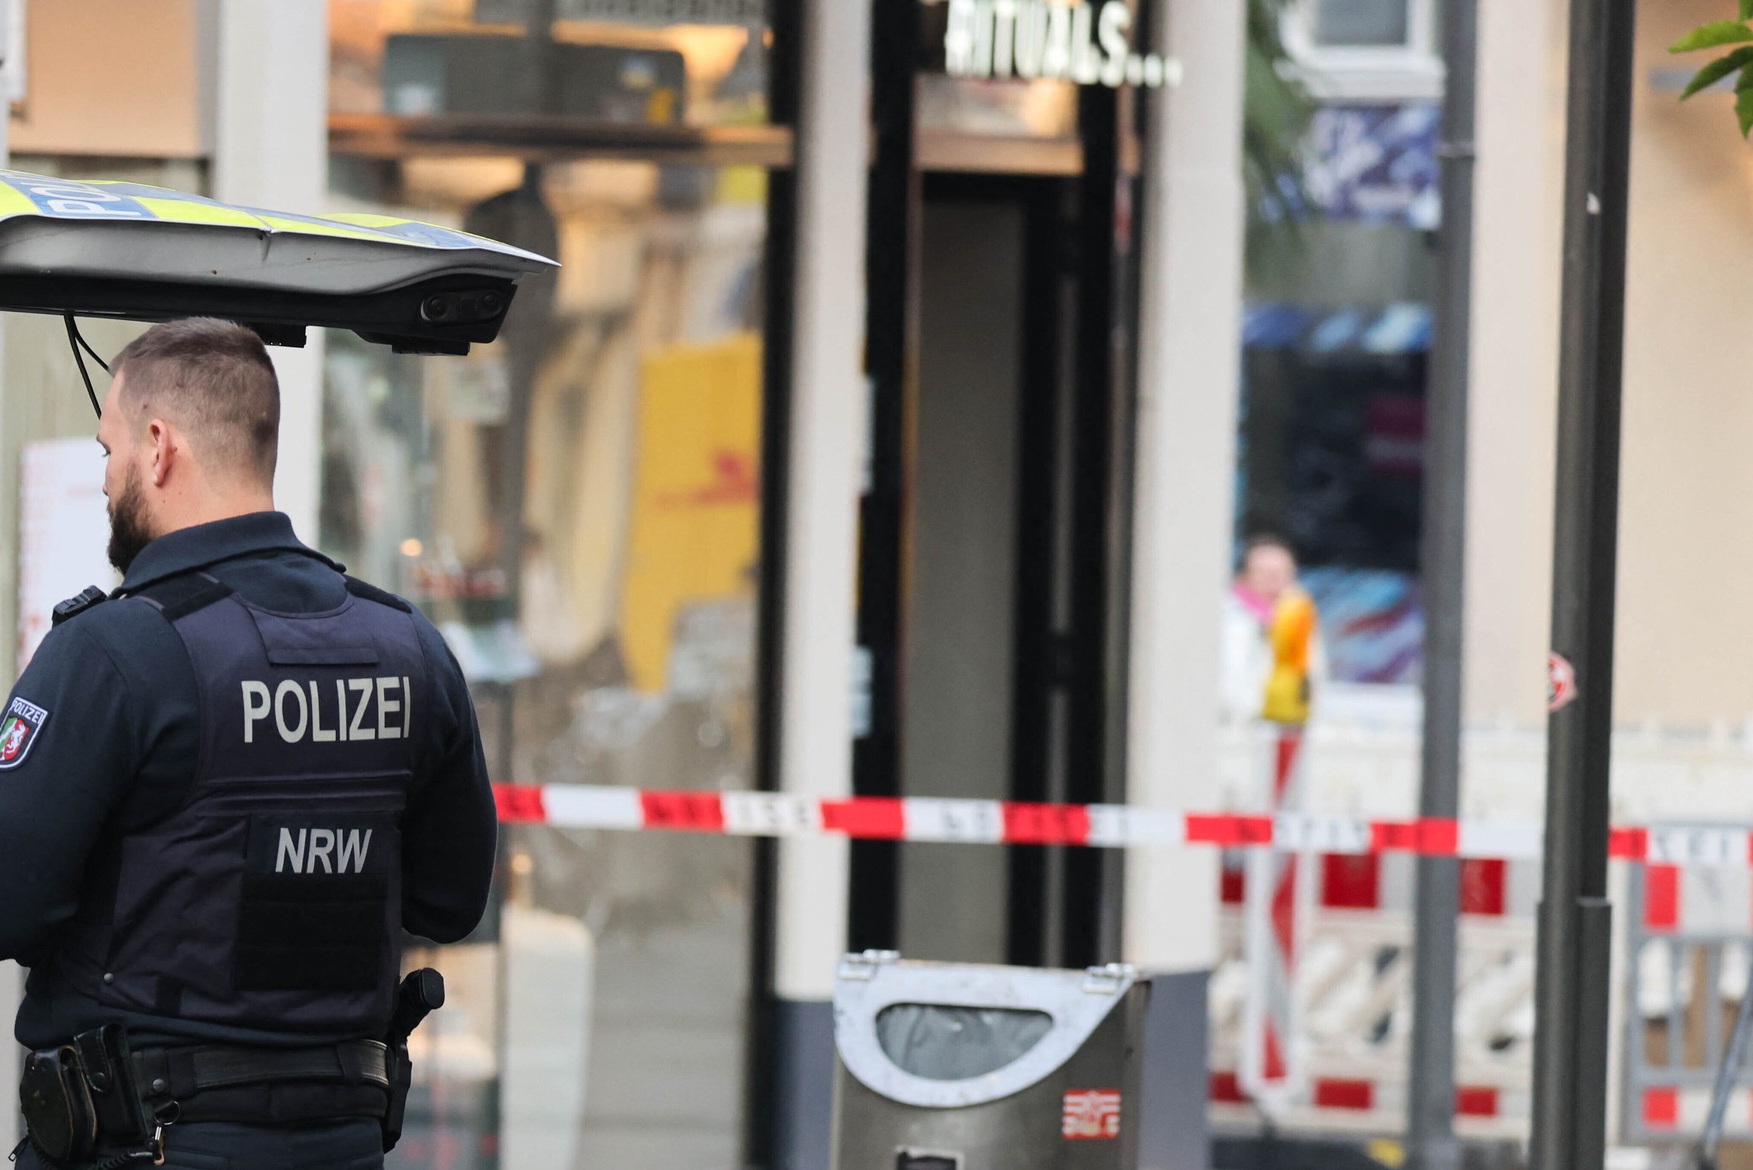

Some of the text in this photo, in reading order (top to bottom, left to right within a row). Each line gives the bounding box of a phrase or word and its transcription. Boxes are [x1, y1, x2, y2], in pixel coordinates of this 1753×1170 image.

[11, 700, 44, 724] POLIZEI
[241, 676, 411, 743] POLIZEI
[275, 827, 373, 874] NRW
